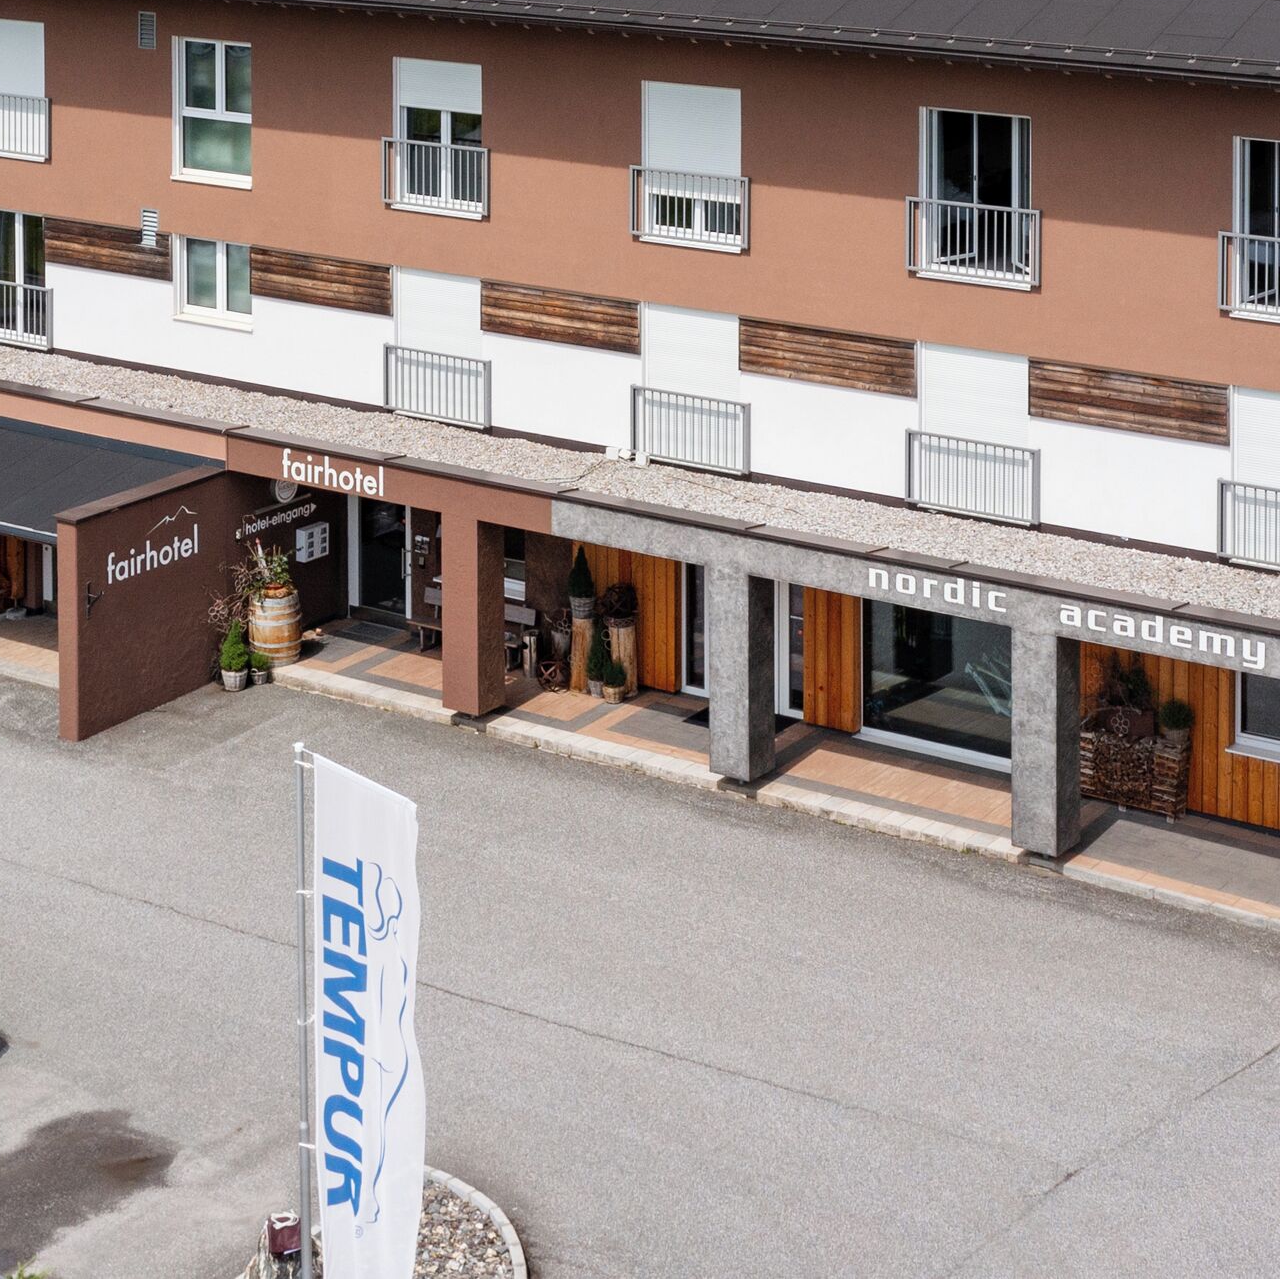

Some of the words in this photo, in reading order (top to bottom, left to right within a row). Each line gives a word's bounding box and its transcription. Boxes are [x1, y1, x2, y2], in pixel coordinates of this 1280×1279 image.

[282, 448, 384, 497] fairhotel
[245, 502, 310, 536] hotel-eingang
[107, 524, 199, 584] fairhotel
[867, 567, 1007, 613] nordic
[1059, 603, 1267, 670] academy
[321, 856, 368, 1218] TEMPUR
